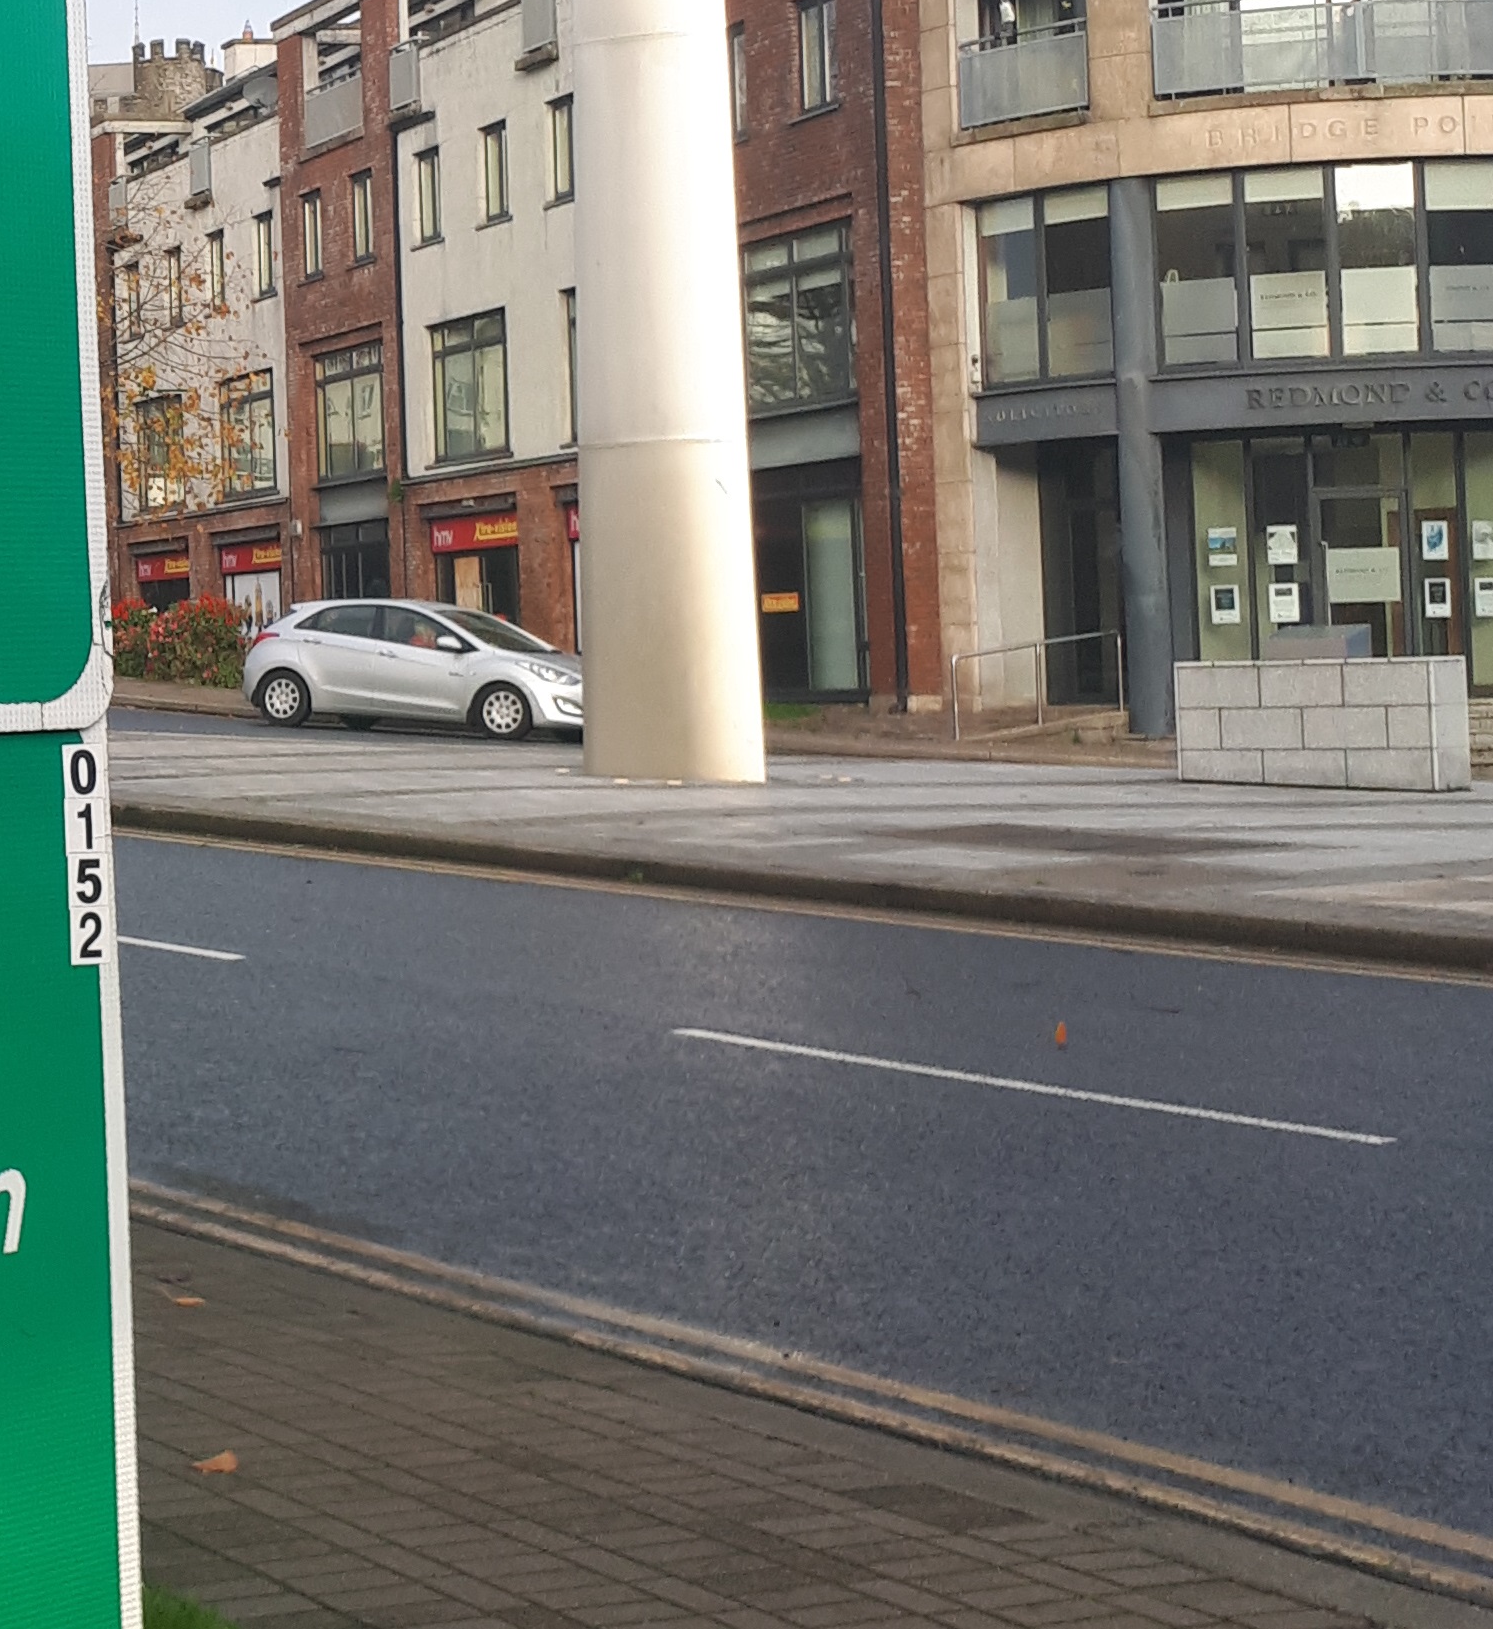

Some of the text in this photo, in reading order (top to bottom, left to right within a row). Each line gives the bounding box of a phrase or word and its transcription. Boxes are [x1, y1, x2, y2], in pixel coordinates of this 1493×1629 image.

[1206, 117, 1380, 148] BRIDGE
[1245, 382, 1411, 410] REDMOND
[1424, 380, 1448, 404] &
[433, 526, 454, 548] hmv
